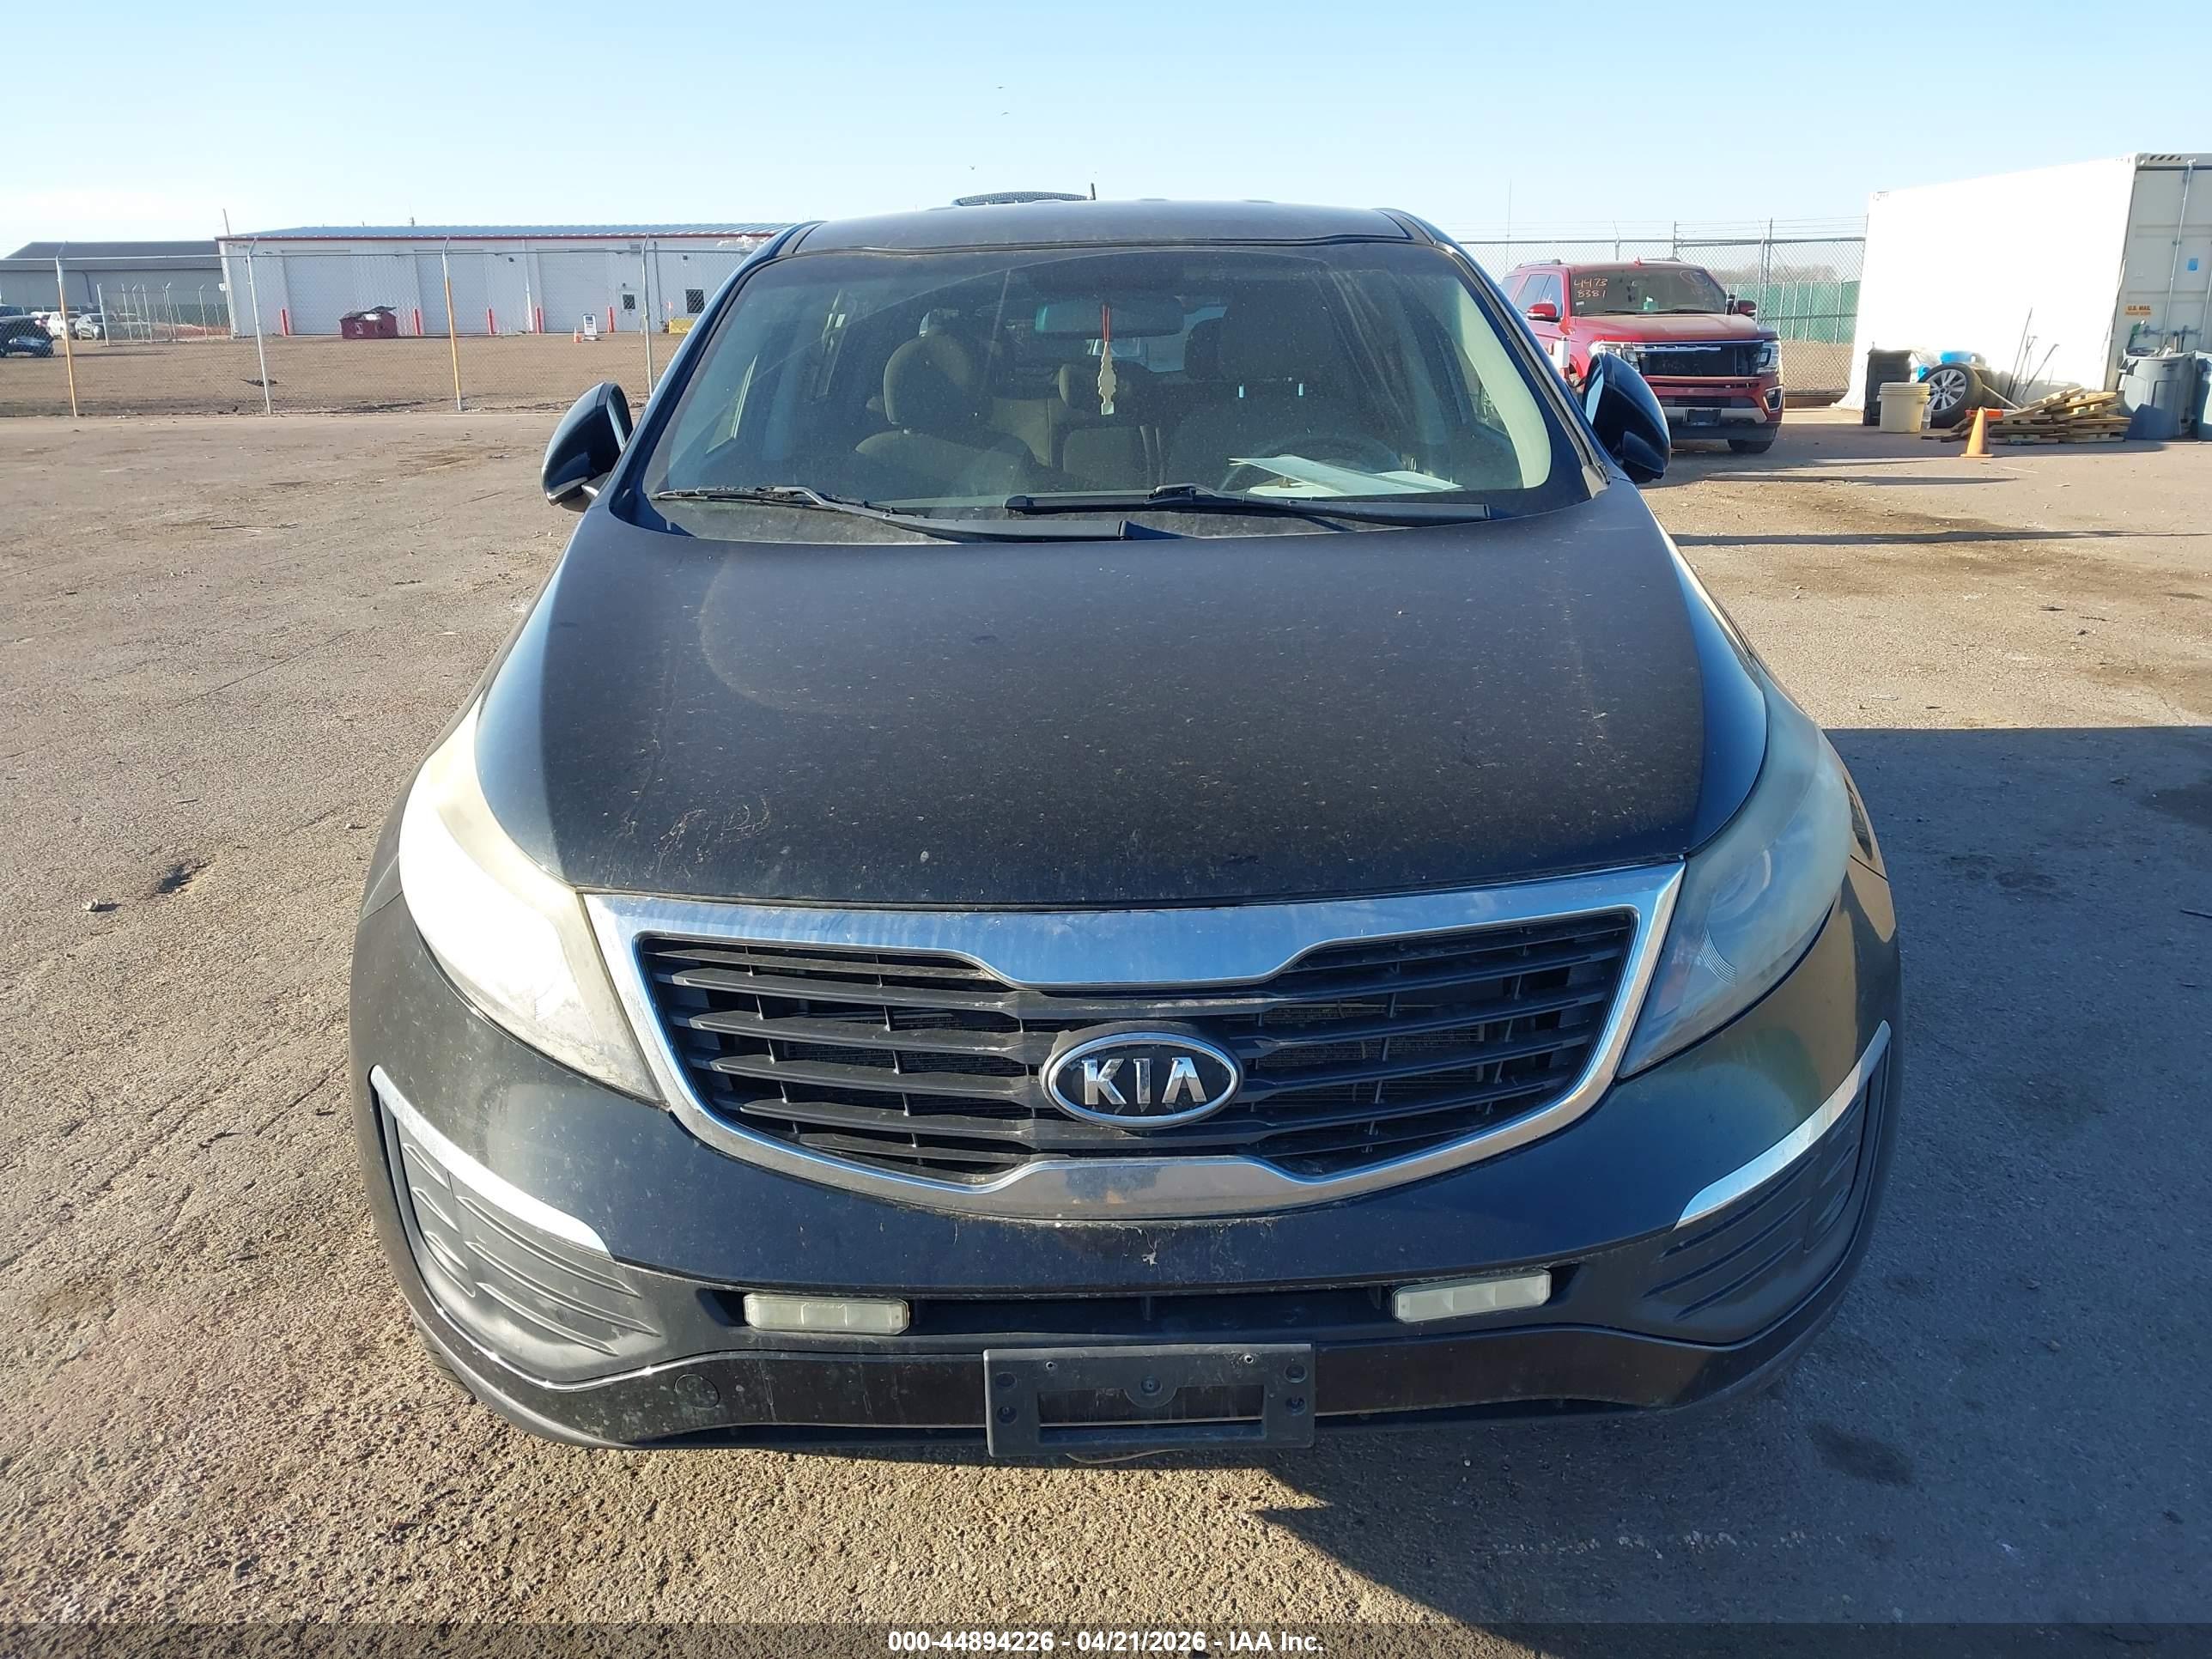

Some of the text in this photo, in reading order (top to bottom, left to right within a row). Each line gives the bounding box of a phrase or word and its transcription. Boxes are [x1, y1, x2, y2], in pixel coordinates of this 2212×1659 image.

[1573, 277, 1608, 289] 4473
[1577, 289, 1607, 299] 8381
[1081, 1057, 1207, 1105] KIA
